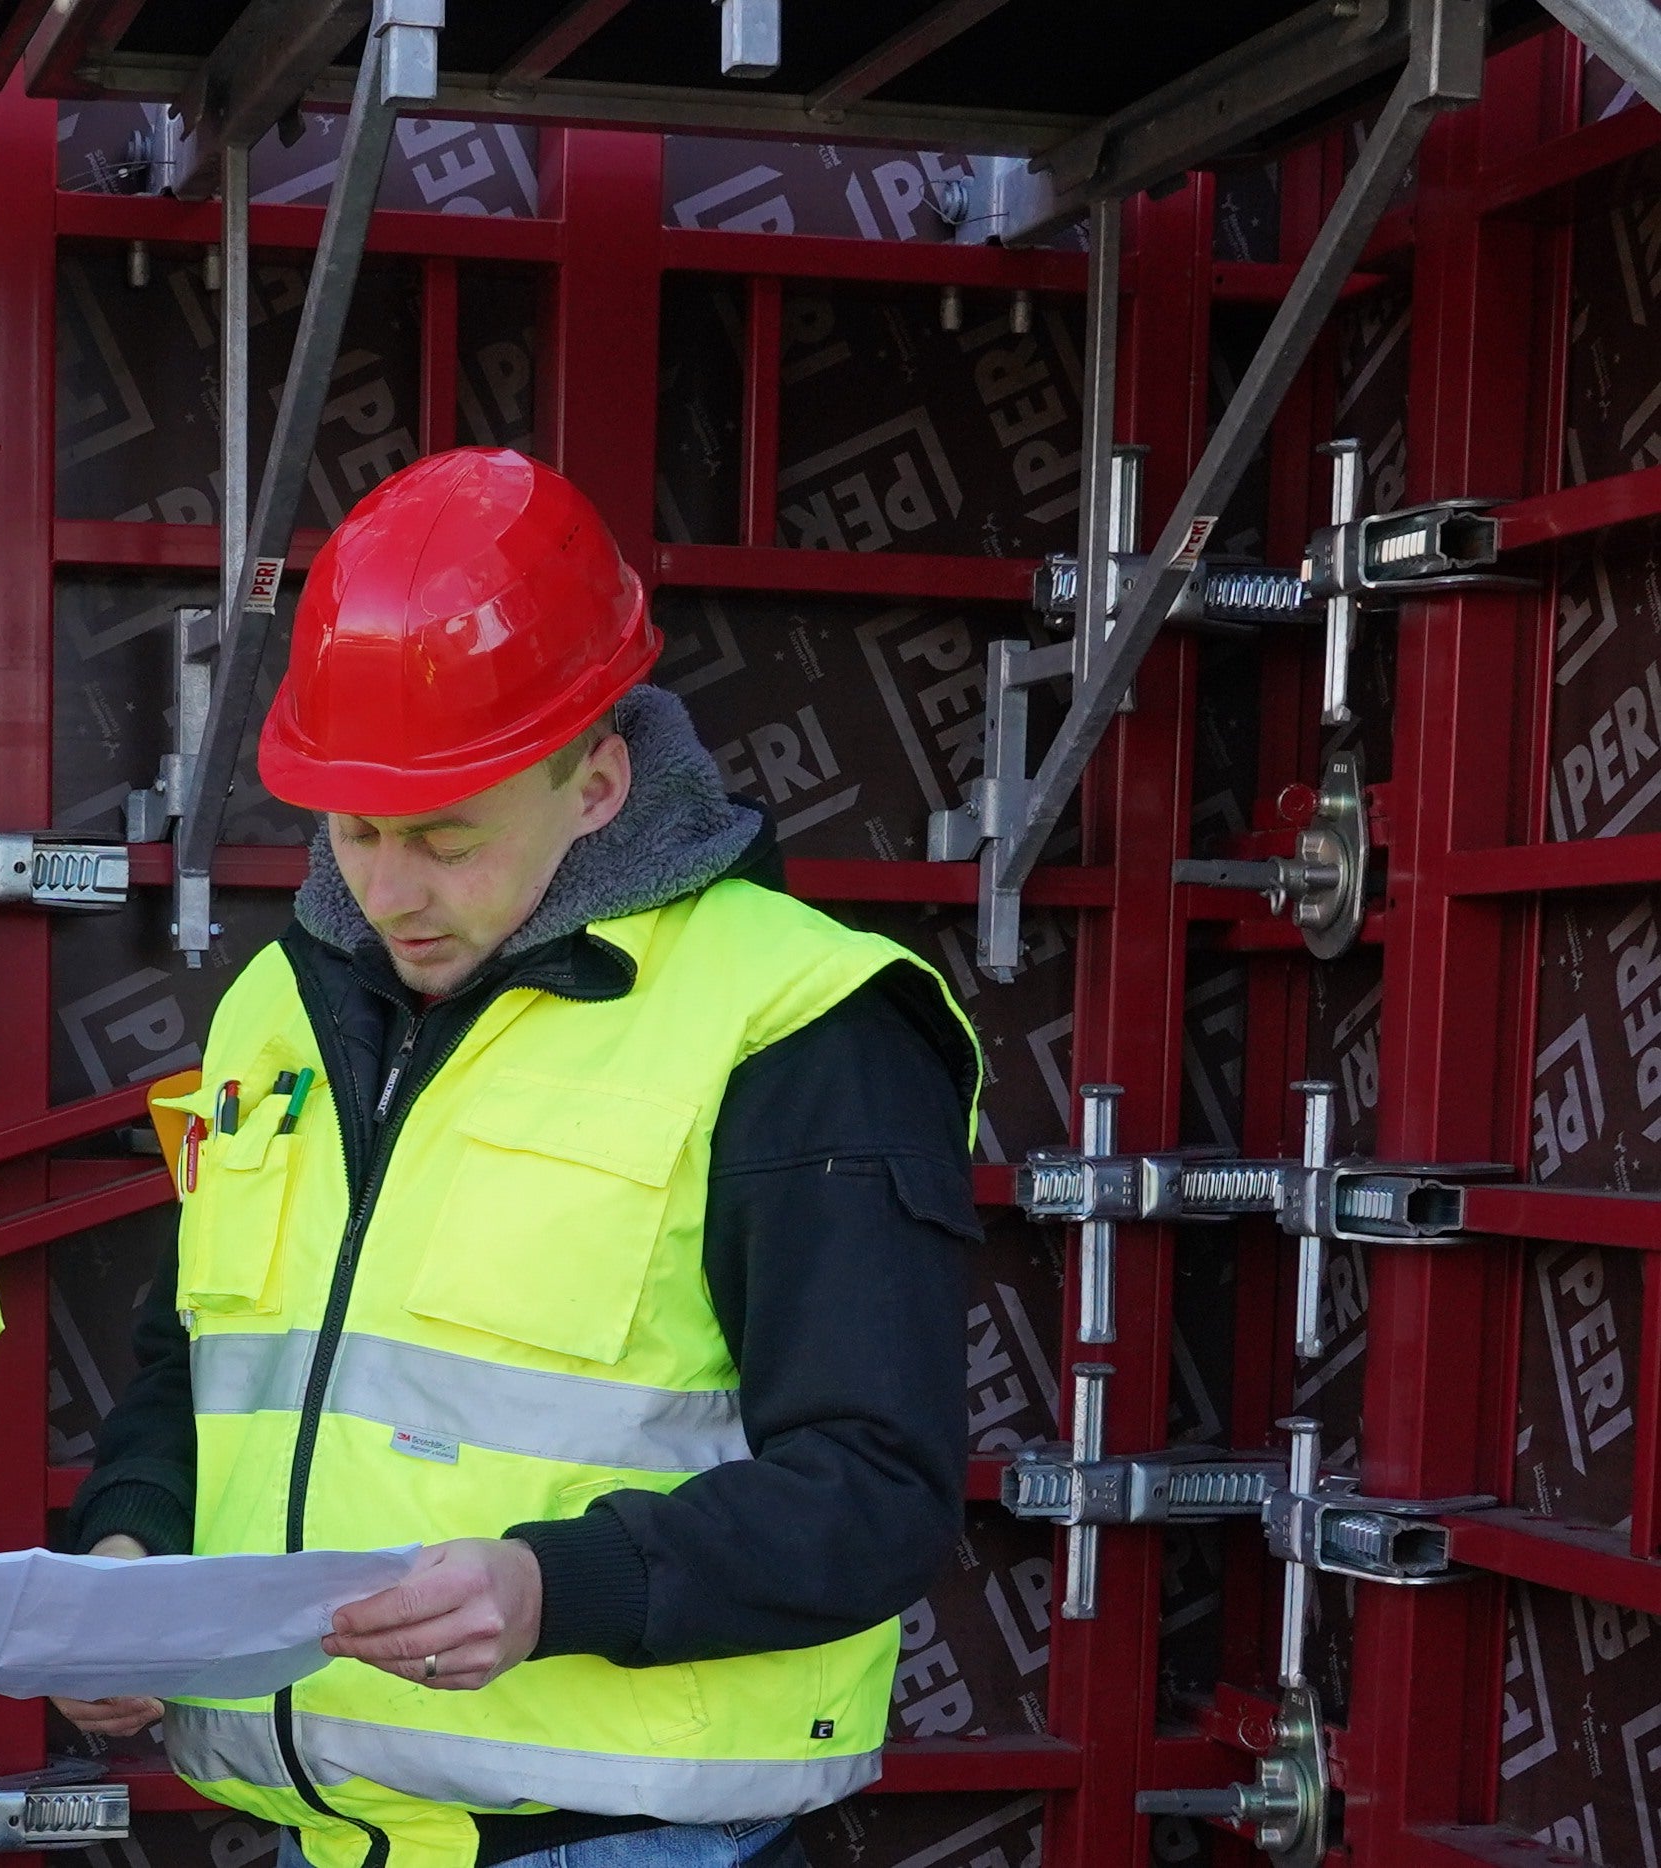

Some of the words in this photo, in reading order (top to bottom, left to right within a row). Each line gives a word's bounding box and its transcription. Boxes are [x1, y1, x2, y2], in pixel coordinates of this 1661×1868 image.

[251, 563, 278, 596] PERI
[1558, 1249, 1634, 1454] PERI
[397, 1432, 411, 1442] 3M
